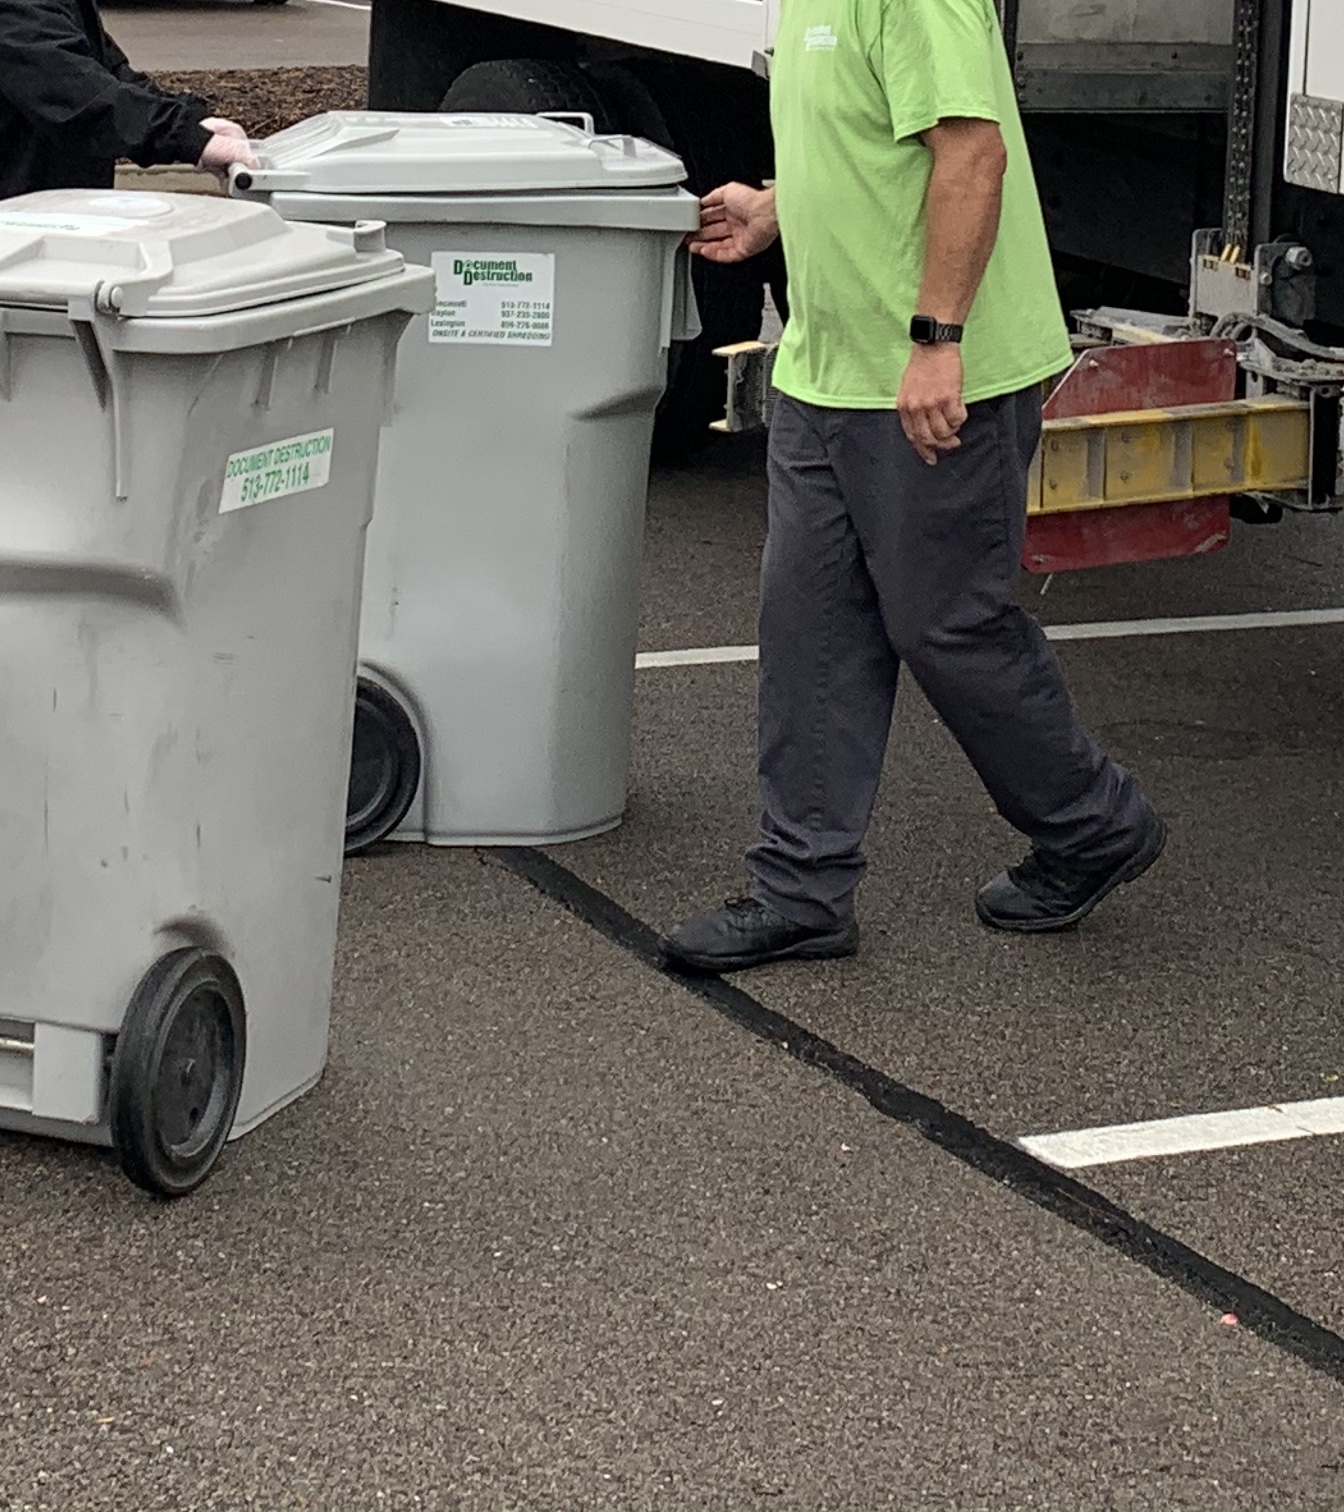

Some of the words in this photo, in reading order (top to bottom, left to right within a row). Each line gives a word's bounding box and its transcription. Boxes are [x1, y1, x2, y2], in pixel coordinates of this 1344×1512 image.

[463, 270, 533, 285] Destruction
[226, 449, 274, 479] DOCUMENT
[274, 435, 332, 464] DESTRUCTION
[240, 461, 310, 502] 513-772-1114
